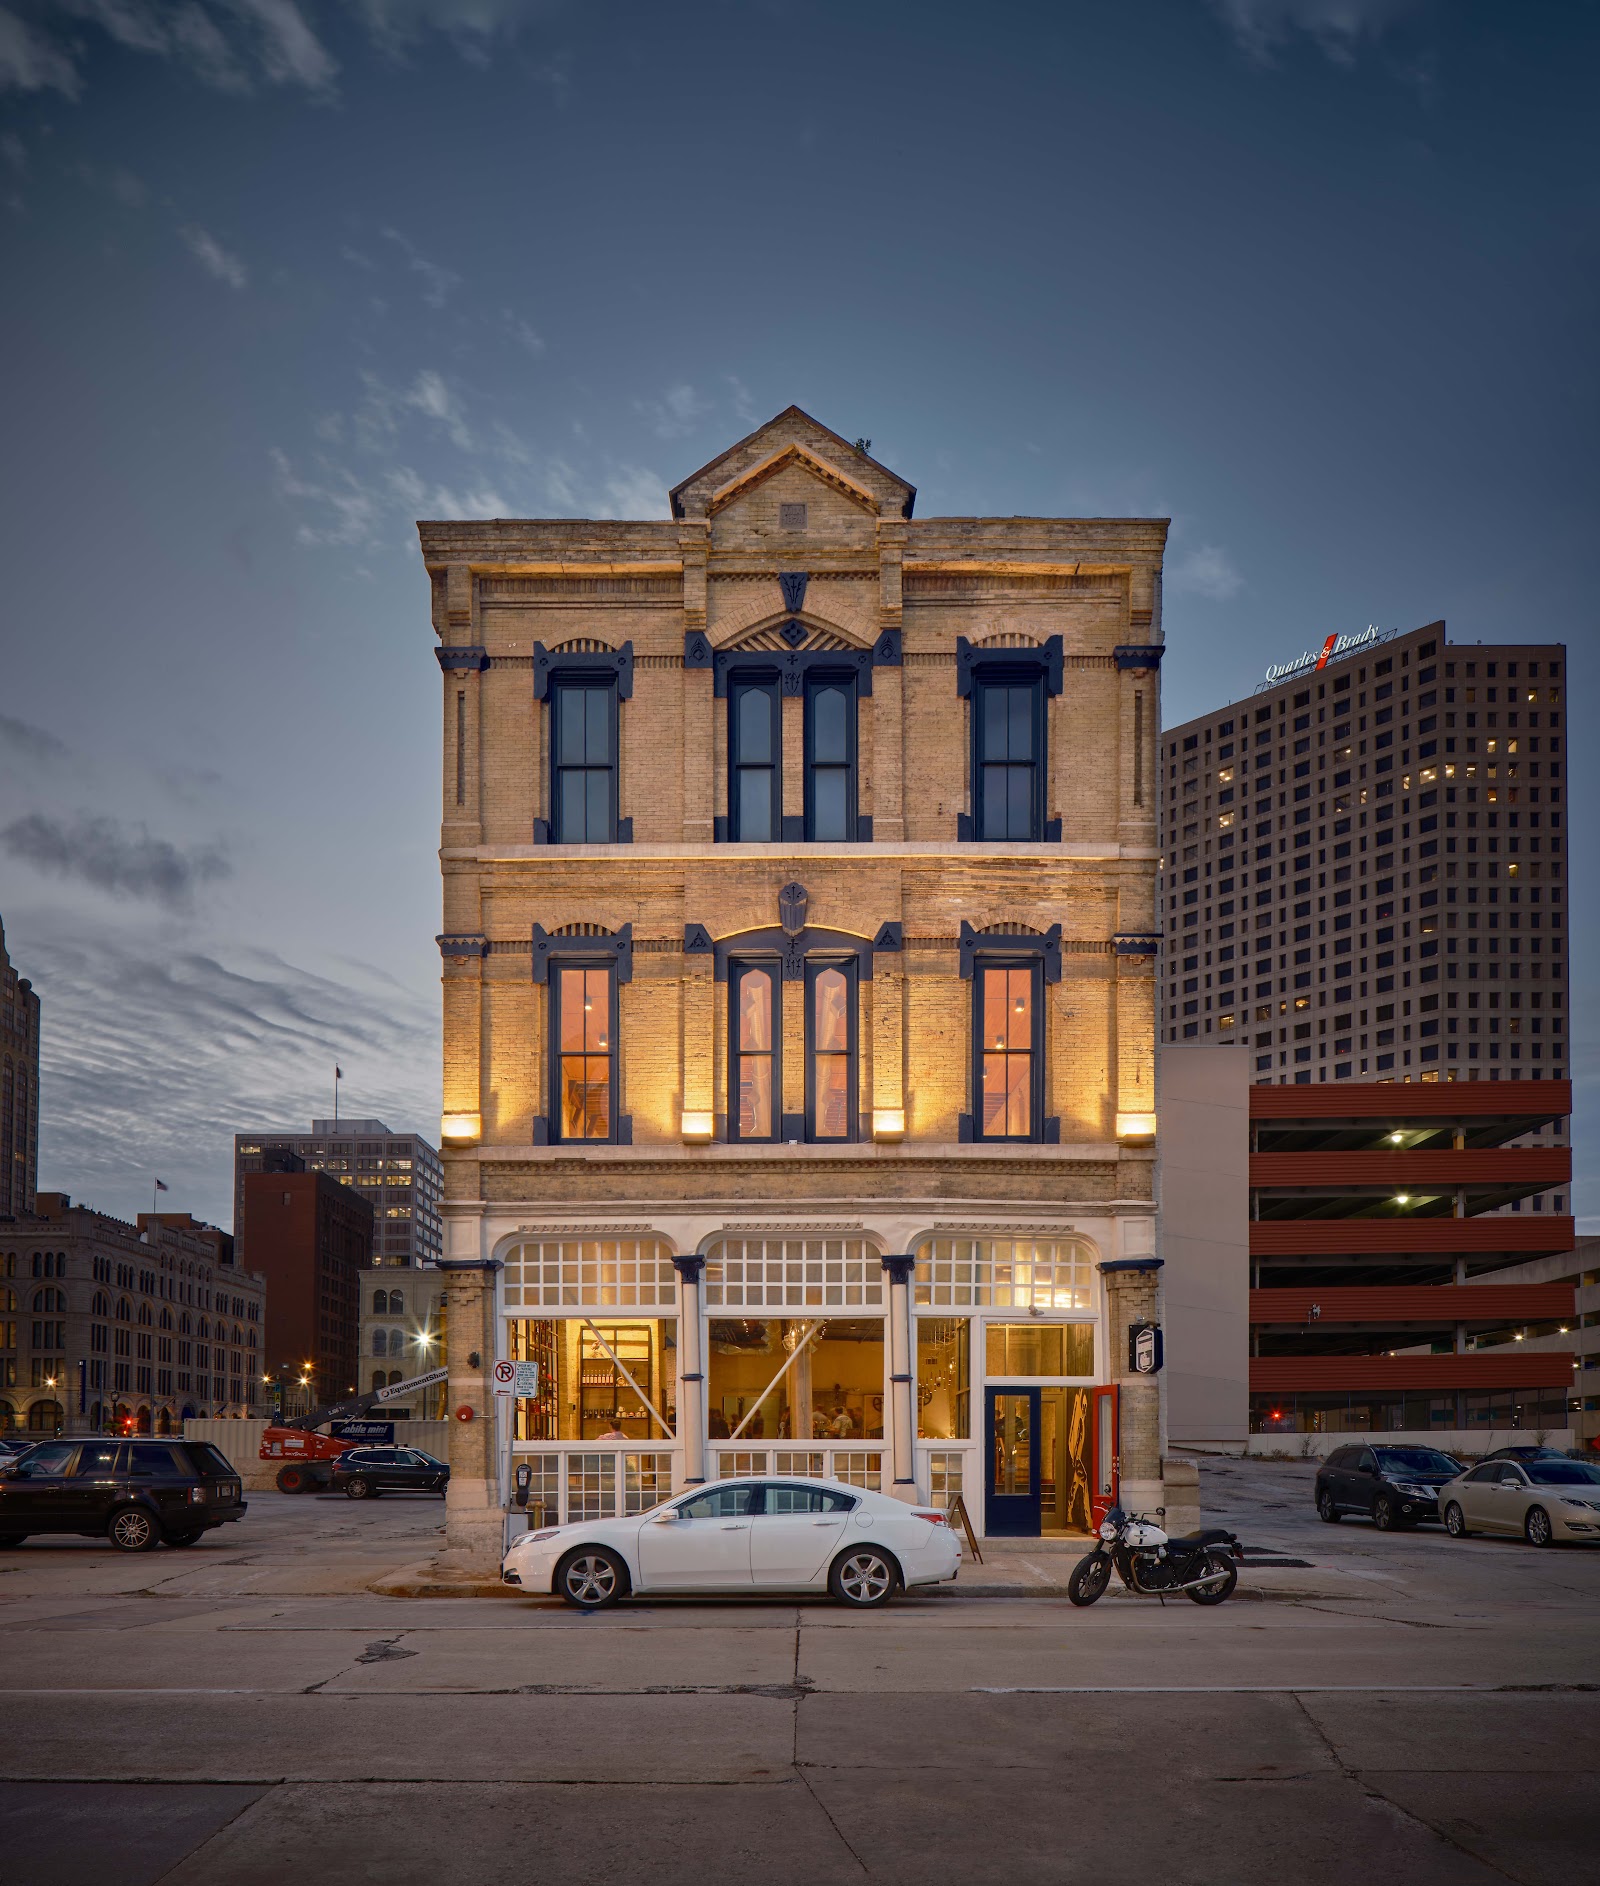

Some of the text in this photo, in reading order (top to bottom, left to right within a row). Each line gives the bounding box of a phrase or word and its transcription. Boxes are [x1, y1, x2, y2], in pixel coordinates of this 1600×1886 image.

[1266, 624, 1379, 682] Quarles & Brady
